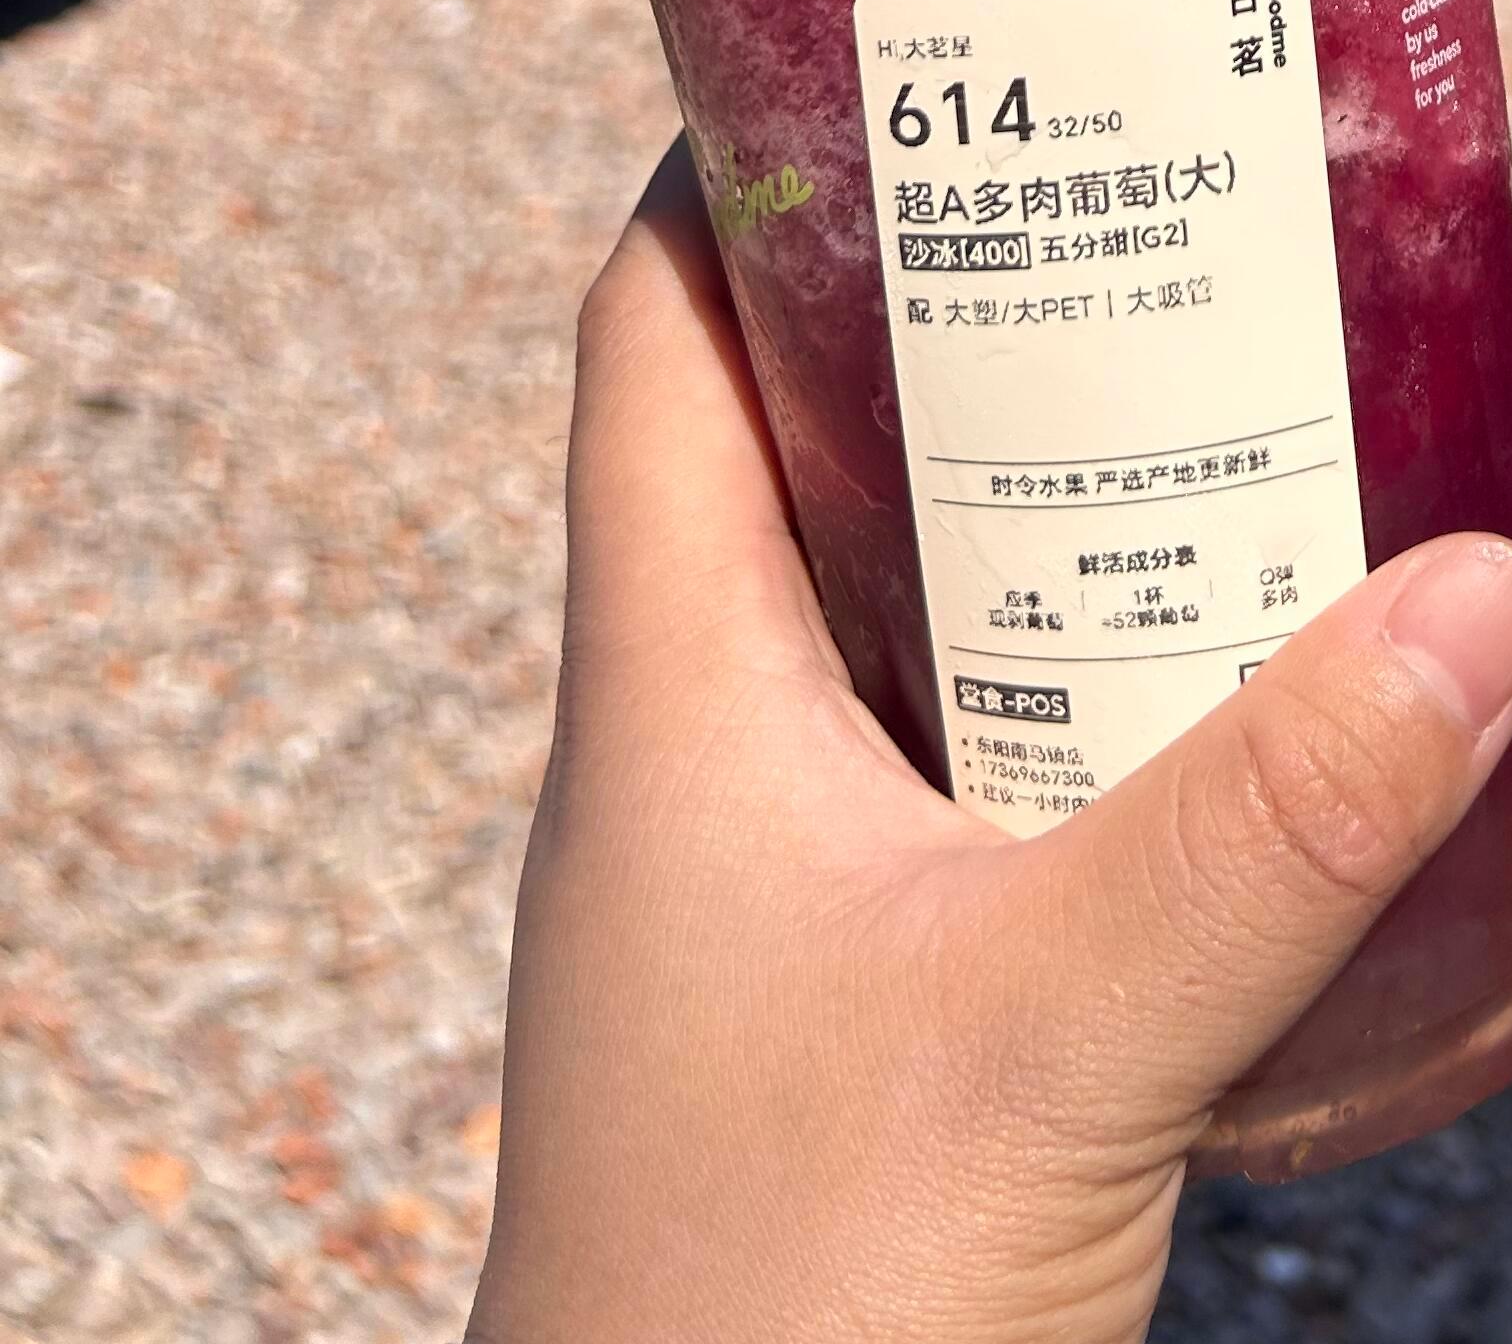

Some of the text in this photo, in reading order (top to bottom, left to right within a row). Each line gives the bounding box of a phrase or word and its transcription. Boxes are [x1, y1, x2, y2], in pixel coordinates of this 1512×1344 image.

[1405, 23, 1438, 55] by us
[1410, 38, 1462, 82] freshness
[1415, 73, 1455, 109] for you
[889, 77, 1123, 147] 614 32/50
[895, 151, 1236, 225] 超A多肉葡萄(大)
[903, 219, 1189, 269] 沙冰[400] 五分甜[G2]
[991, 446, 1272, 499] 时令水果 严选产地更新鲜
[957, 681, 1067, 719] 堂食-POS
[980, 759, 1095, 788] 17369667300
[983, 783, 1098, 816] 建议一小时内
